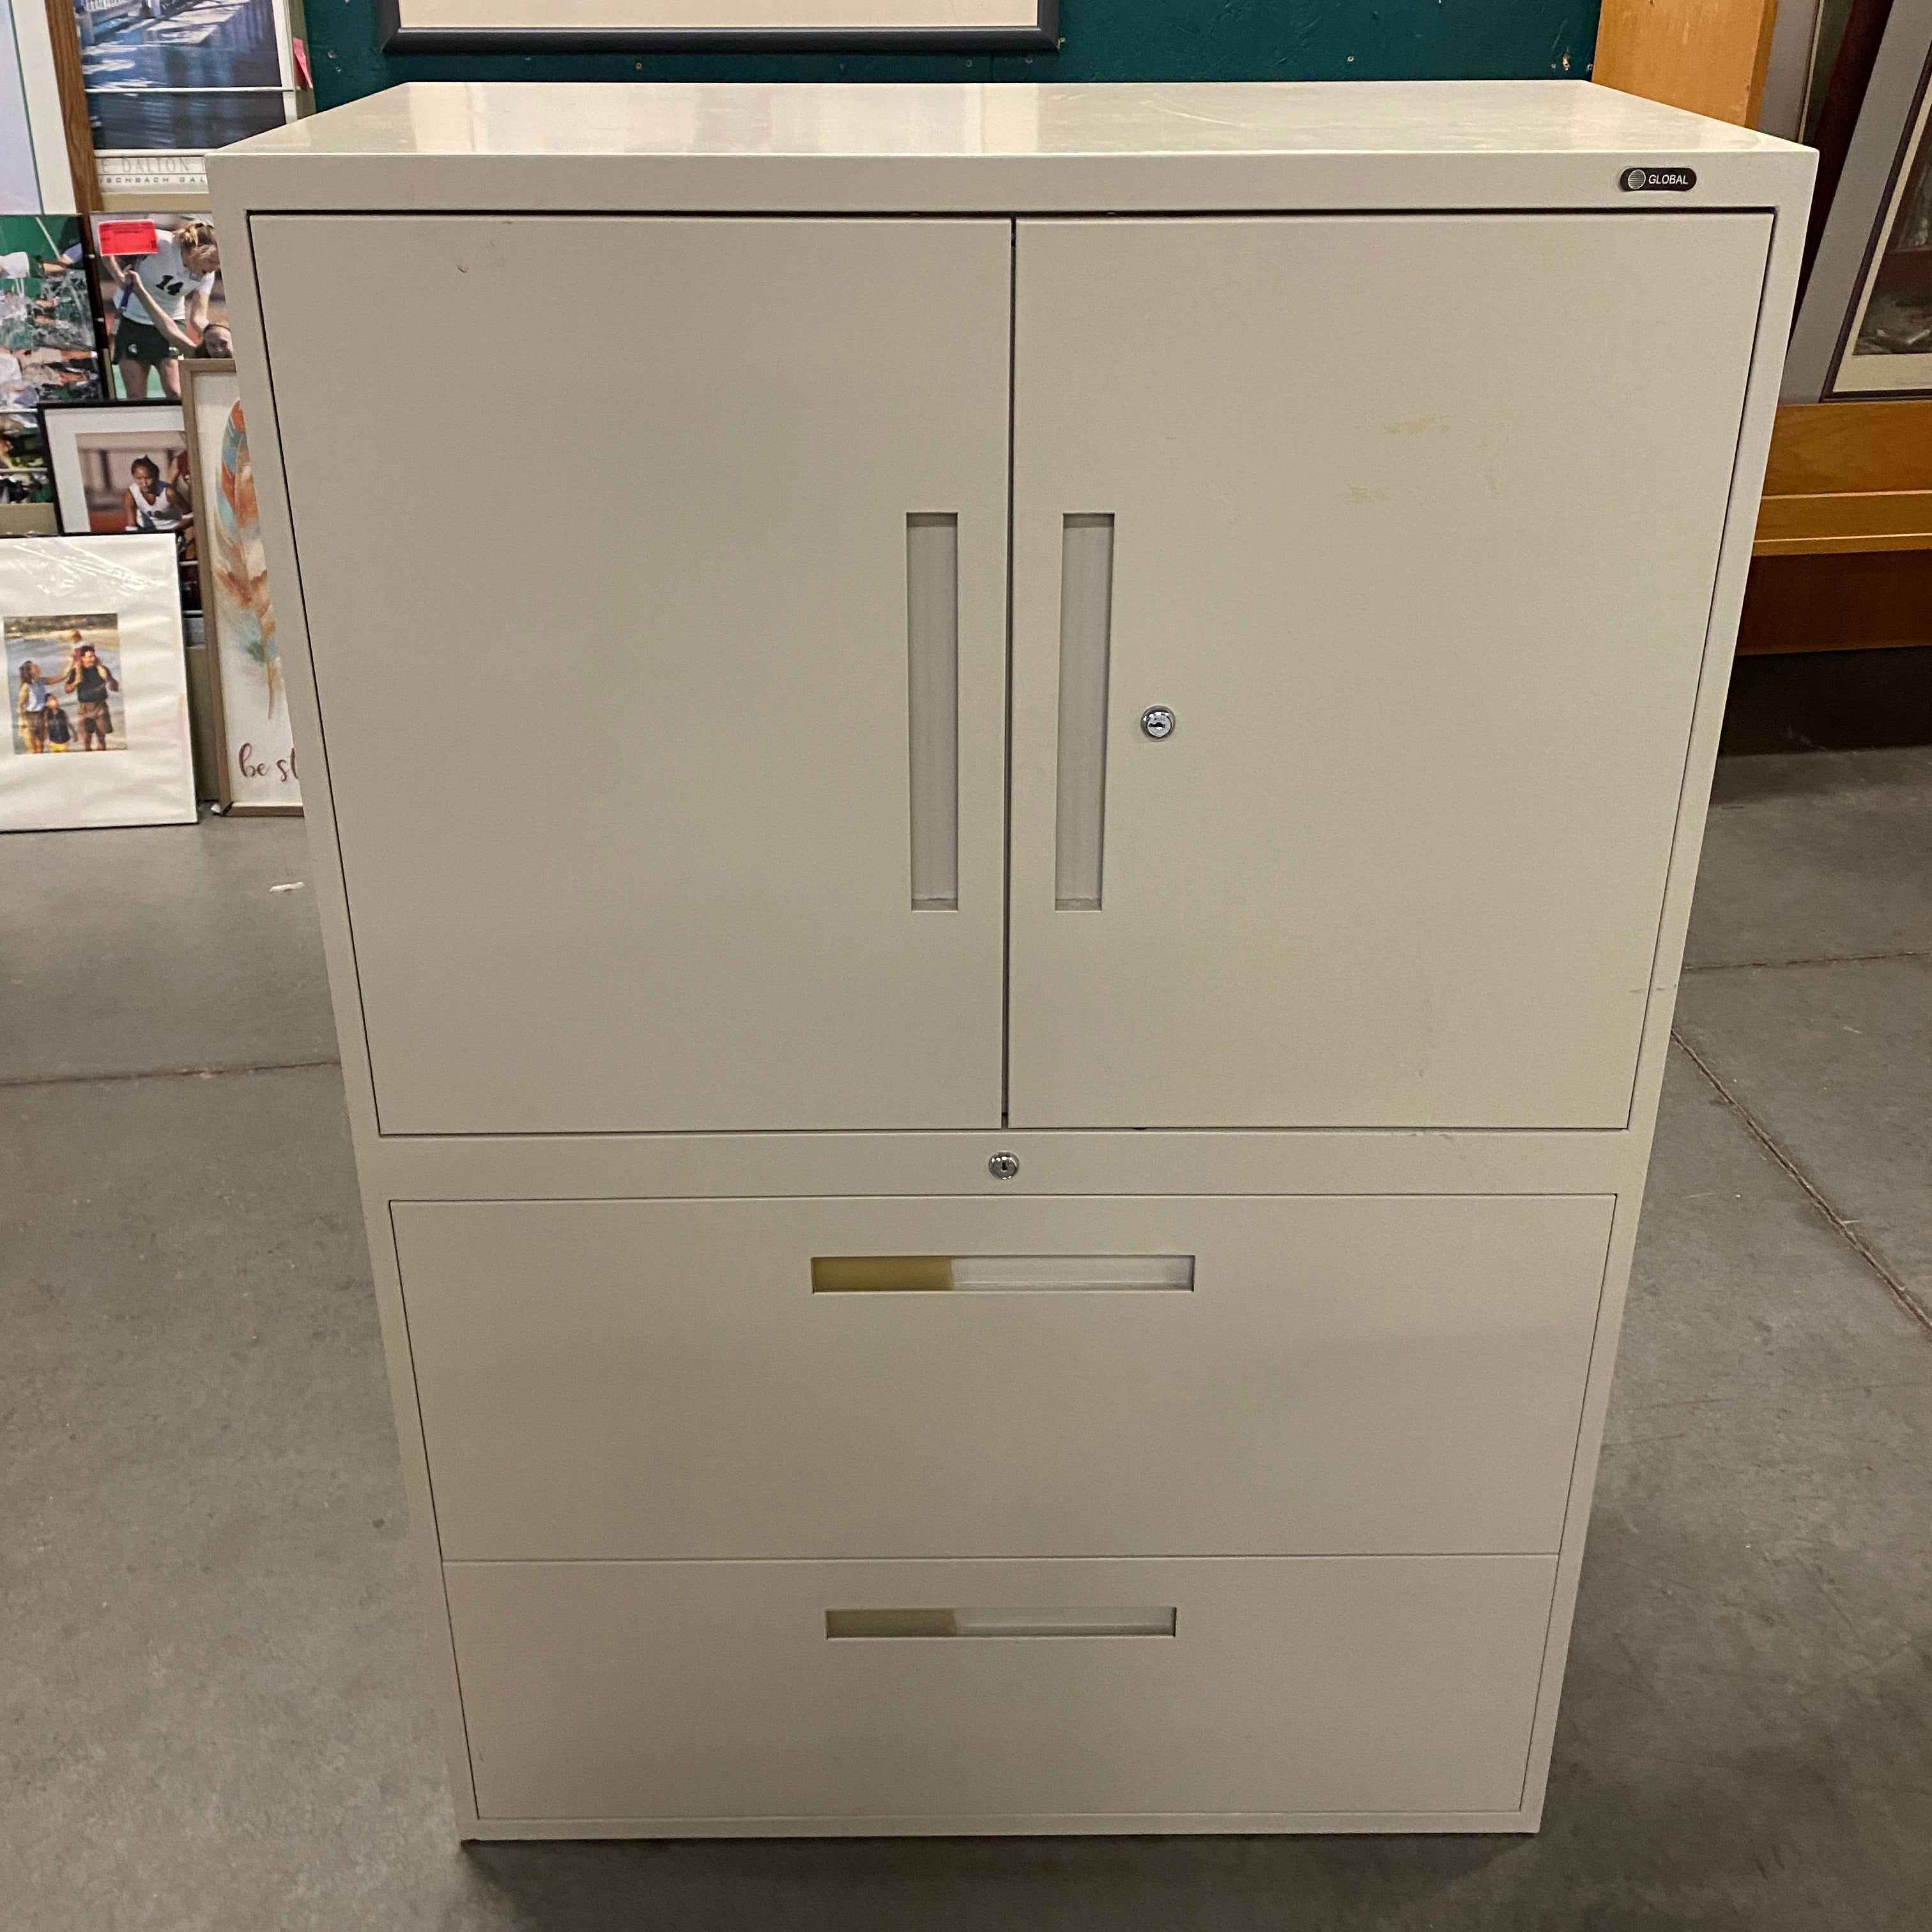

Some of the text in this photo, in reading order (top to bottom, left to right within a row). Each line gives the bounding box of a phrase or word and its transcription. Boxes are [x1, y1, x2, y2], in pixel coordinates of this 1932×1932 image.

[123, 158, 189, 173] DALTON
[1648, 174, 1688, 184] GLOBAL
[156, 275, 183, 295] 14
[239, 743, 270, 777] be
